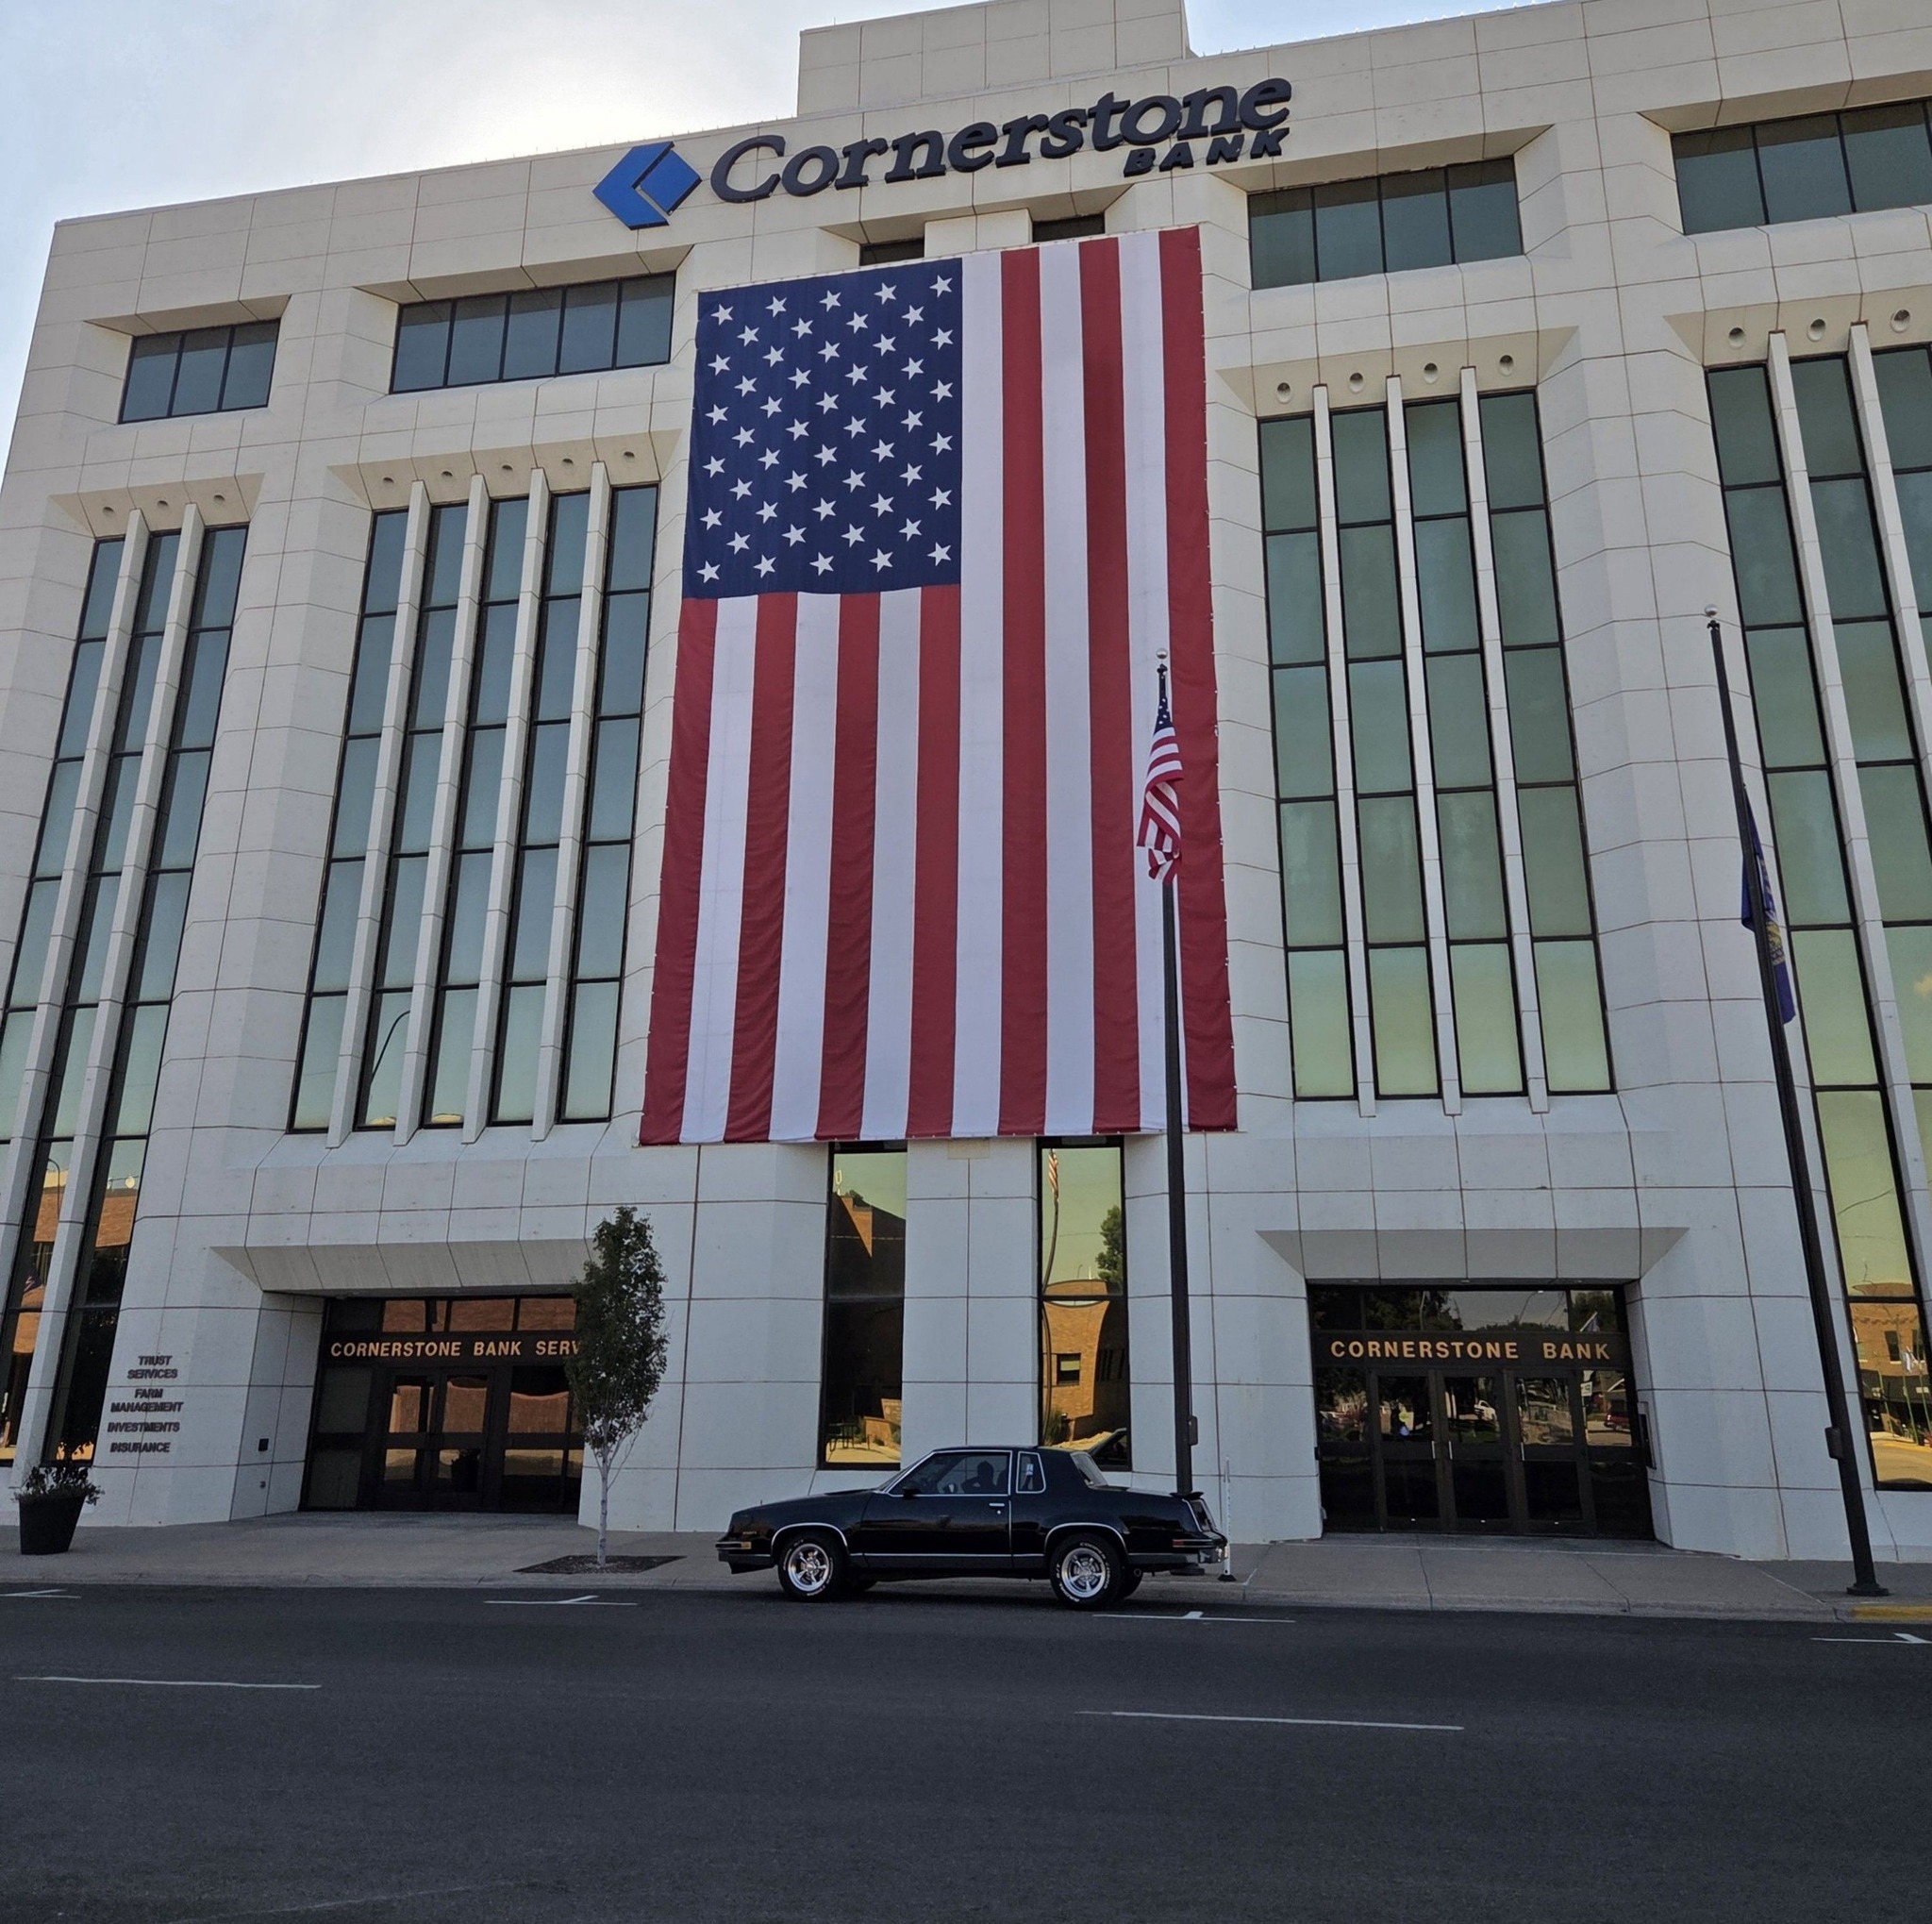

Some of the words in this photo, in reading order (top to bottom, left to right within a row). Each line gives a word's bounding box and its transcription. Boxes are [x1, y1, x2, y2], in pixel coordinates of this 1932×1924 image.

[709, 77, 1291, 202] Cornerstone
[1124, 127, 1289, 177] BANK
[330, 1342, 461, 1357] CORNERSTONE
[474, 1341, 522, 1356] BANK
[1330, 1341, 1519, 1359] CORNERSTONE
[1542, 1343, 1610, 1360] BANK
[138, 1355, 173, 1365] TRUST
[126, 1369, 178, 1380] SERVICES
[134, 1388, 163, 1398] FARM
[110, 1401, 184, 1413] MANAGEMENT
[107, 1422, 180, 1432] INVESTMENTS
[109, 1442, 171, 1453] INSURANCE
